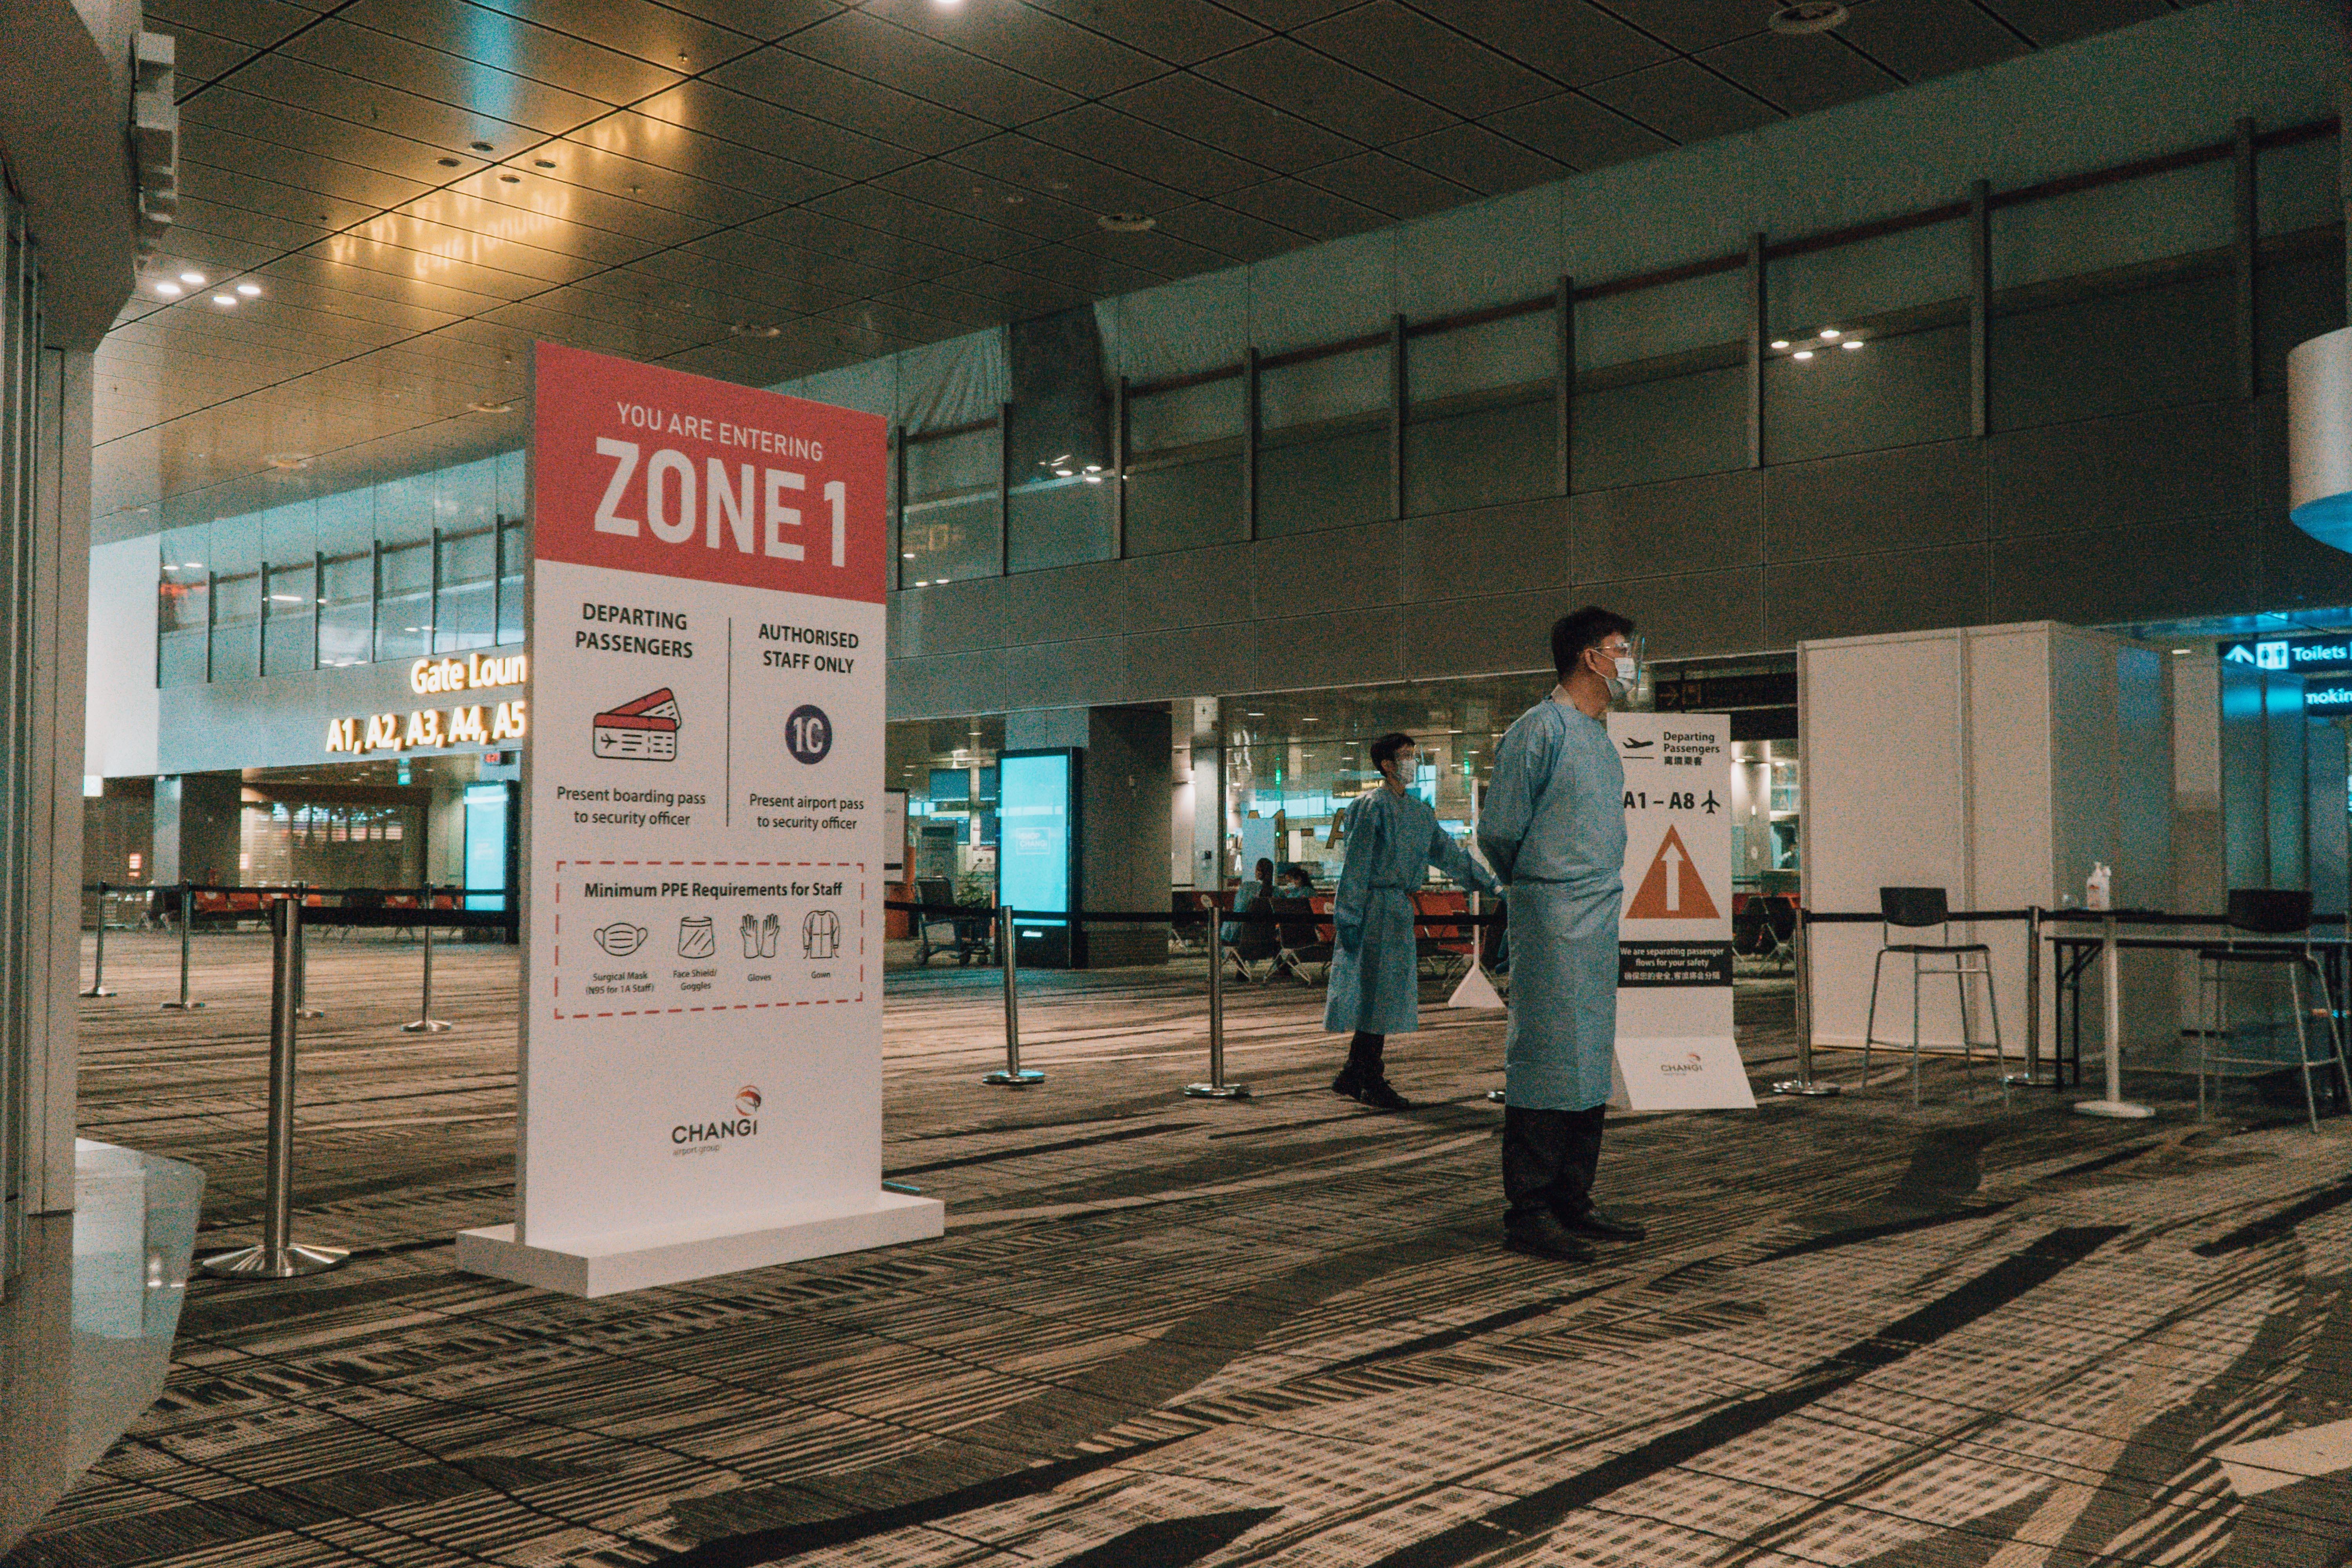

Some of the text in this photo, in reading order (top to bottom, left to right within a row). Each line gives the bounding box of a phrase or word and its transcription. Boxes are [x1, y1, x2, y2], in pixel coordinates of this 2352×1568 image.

[617, 401, 823, 462] YOU ARE ENTERING
[594, 436, 845, 567] ZONE 1
[583, 603, 687, 630] DEPARTING
[575, 631, 693, 658] PASSENGERS
[759, 623, 859, 649] AUTHORISED
[2291, 645, 2347, 661] Toilets
[763, 651, 854, 674] STAFF ONLY
[411, 658, 464, 694] Gate
[326, 701, 526, 755] A1, A2, A3, A4, A5
[793, 717, 822, 753] 1C
[1664, 731, 1715, 743] Departing
[1664, 744, 1720, 755] Passengers
[557, 787, 706, 806] Present boarding pass
[750, 793, 864, 810] Present airport pass
[1624, 791, 1646, 809] A1
[1669, 792, 1695, 809] A8
[574, 811, 690, 827] to security officer
[757, 816, 857, 831] to security officer
[585, 882, 842, 900] Minimum PPE Requirements for Staff
[1647, 947, 1685, 956] separating
[1687, 948, 1724, 956] passenger
[1687, 959, 1709, 968] safety
[593, 972, 625, 982] Surgical
[691, 969, 717, 977] Shield/
[586, 986, 604, 995] (N95
[607, 985, 618, 994] for
[633, 983, 654, 993] Staff)
[681, 982, 711, 992] Goggles
[672, 1119, 757, 1144] CHANGI
[673, 1144, 720, 1156] airport group
